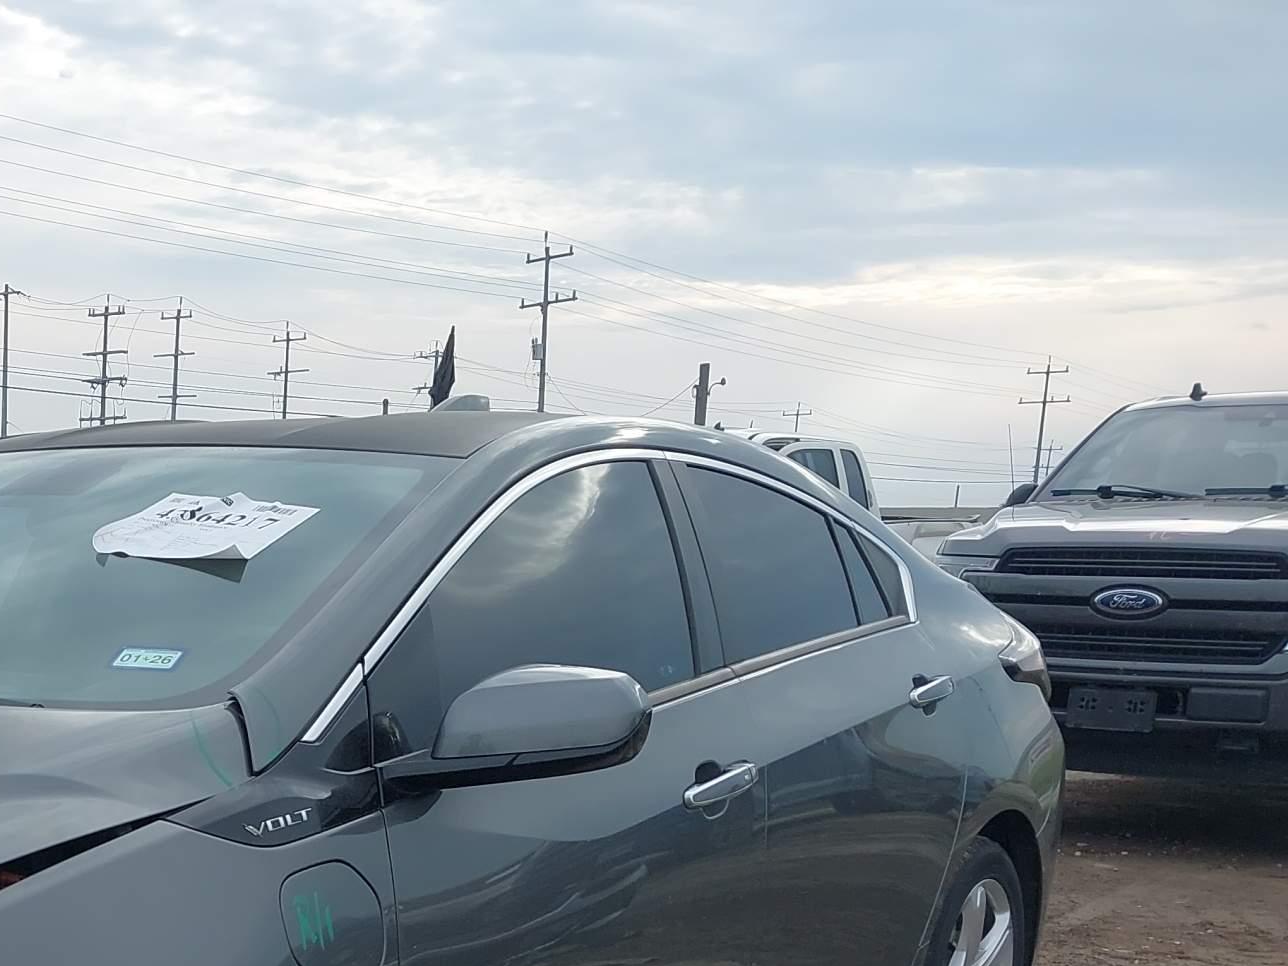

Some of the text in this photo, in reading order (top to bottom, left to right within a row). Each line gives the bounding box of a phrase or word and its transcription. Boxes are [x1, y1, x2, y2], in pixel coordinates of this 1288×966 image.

[156, 506, 281, 530] 4864217
[1109, 593, 1147, 609] Ford
[242, 807, 313, 838] VOLT
